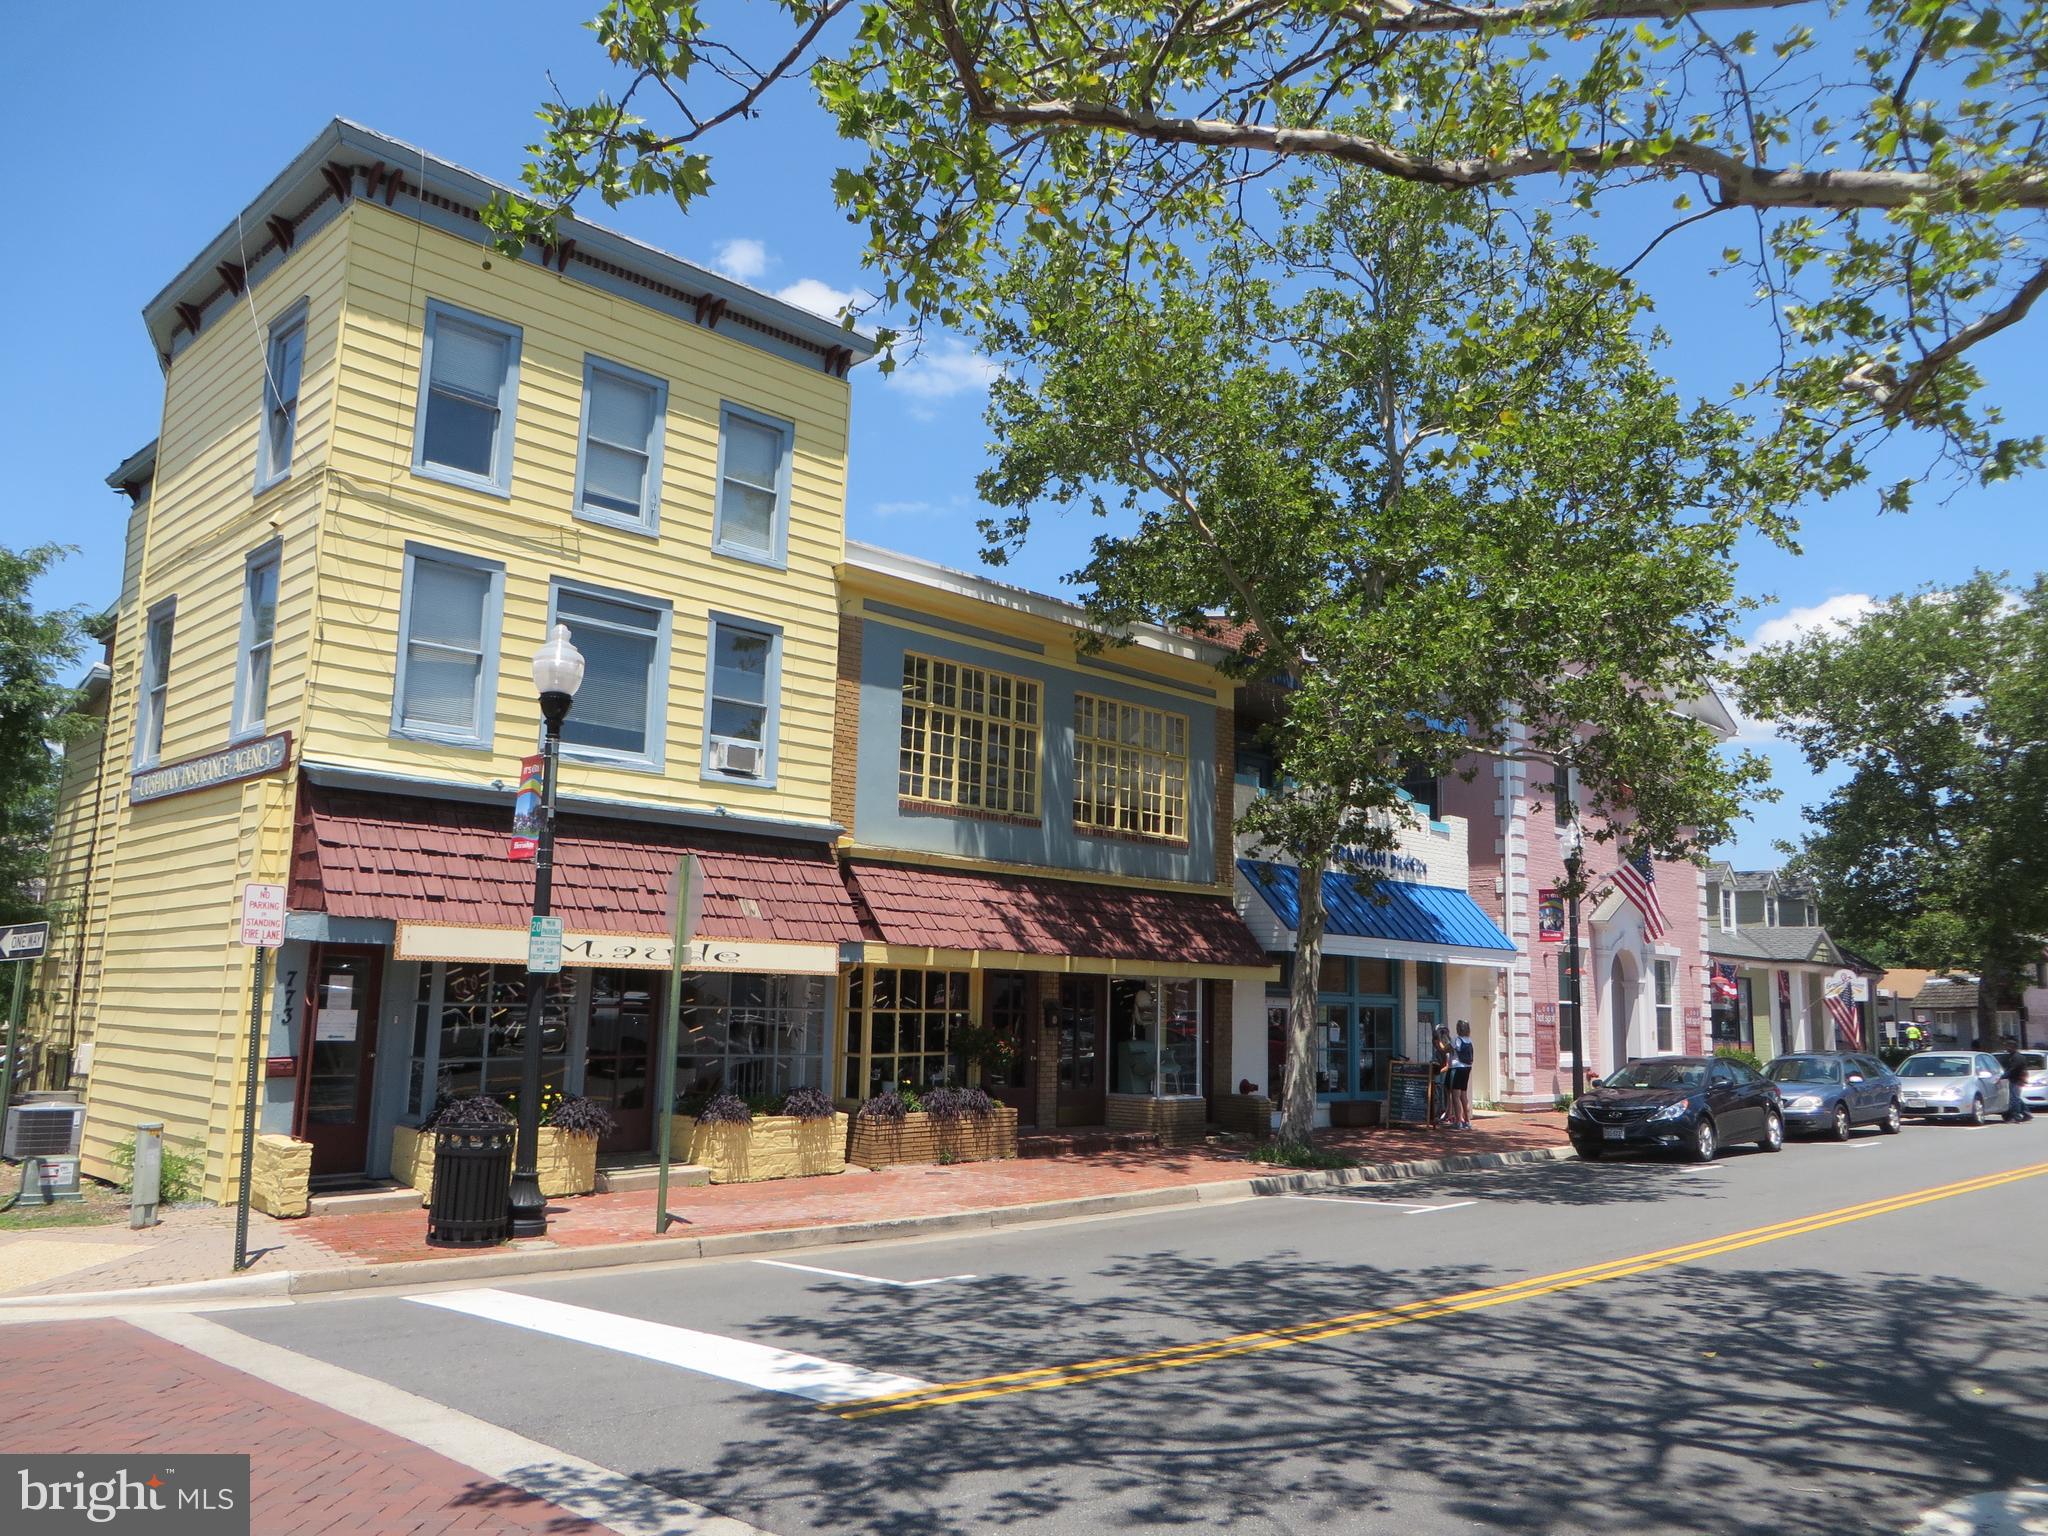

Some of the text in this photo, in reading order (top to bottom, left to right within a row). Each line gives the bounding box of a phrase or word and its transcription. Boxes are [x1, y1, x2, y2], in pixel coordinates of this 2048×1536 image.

[139, 743, 273, 797] CUSHMAN INSURANCE AGENCY
[260, 891, 271, 899] NO
[249, 900, 280, 910] PARKING
[246, 918, 281, 928] STANDING
[532, 921, 541, 932] 20
[244, 928, 281, 940] FIRE LANE
[10, 933, 42, 949] ONE WAY
[562, 940, 741, 964] Maude
[281, 970, 298, 1025] 773
